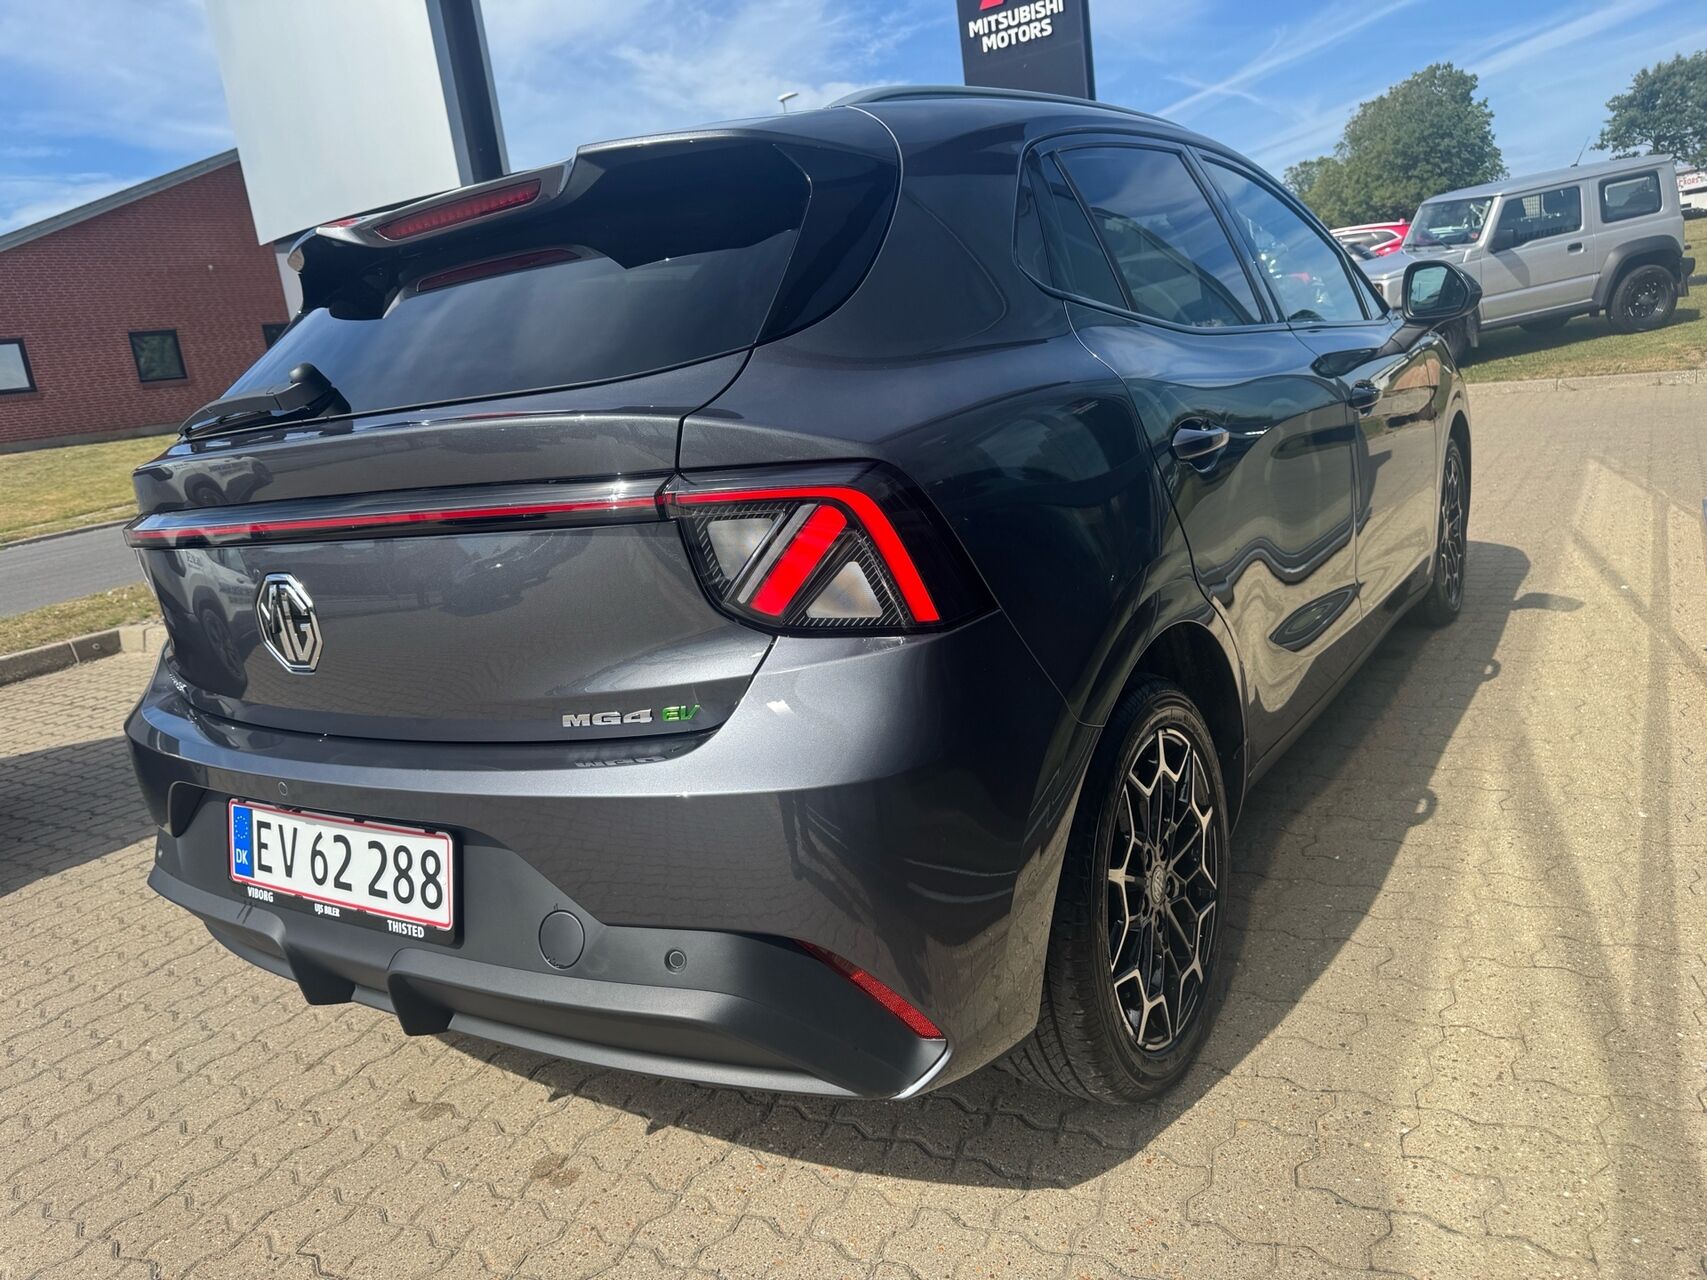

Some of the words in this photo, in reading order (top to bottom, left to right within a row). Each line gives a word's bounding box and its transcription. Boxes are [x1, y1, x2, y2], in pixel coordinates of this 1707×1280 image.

[968, 0, 1064, 38] MITSUBISHI
[982, 18, 1053, 53] MOTORS
[260, 584, 315, 662] MG
[562, 709, 653, 728] MG4
[662, 705, 701, 722] EV
[236, 849, 248, 865] DK
[257, 820, 298, 878] EV
[310, 832, 353, 892] 62
[368, 840, 443, 910] 288
[247, 887, 274, 903] VIBORG
[387, 920, 425, 939] THISTED
